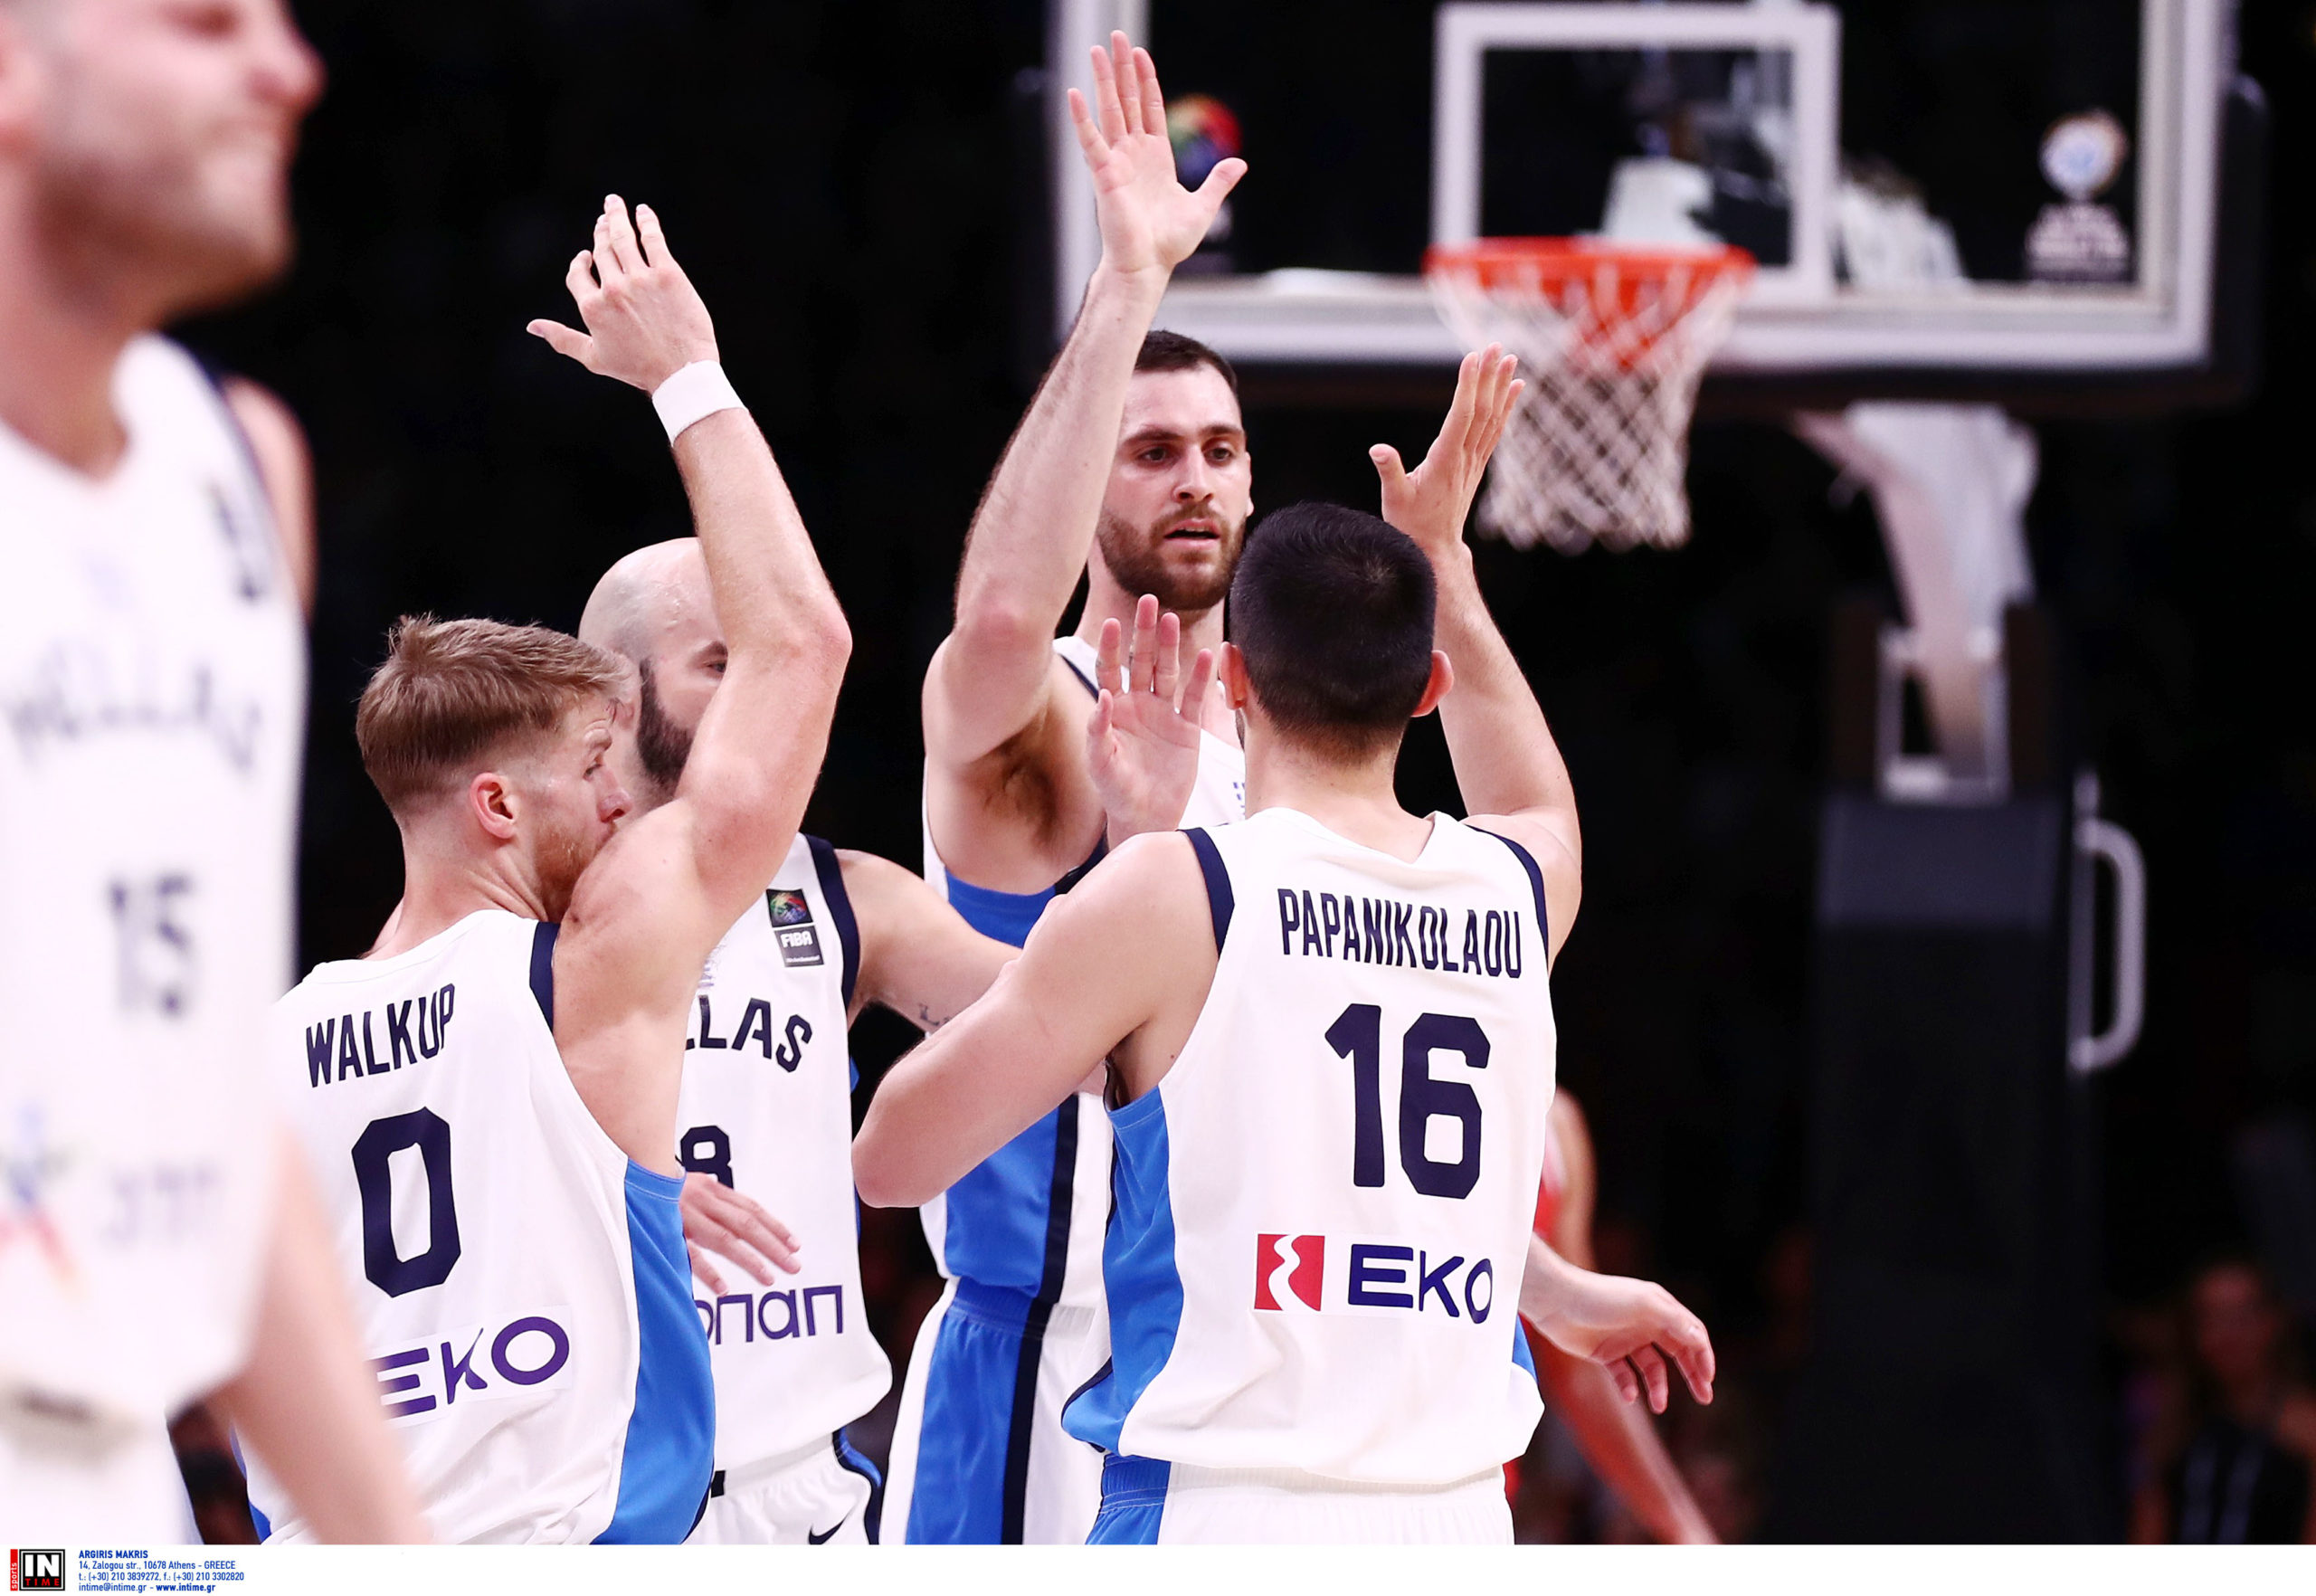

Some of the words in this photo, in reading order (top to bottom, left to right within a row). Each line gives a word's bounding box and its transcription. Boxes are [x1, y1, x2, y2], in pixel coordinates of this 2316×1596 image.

[105, 870, 194, 1015] 15
[781, 931, 813, 947] FIBA
[1277, 888, 1522, 979] PAPANIKOLAOU
[306, 983, 455, 1088] WALKUP
[685, 994, 813, 1073] LAS
[1324, 1003, 1490, 1200] 16
[351, 1107, 461, 1297] 0
[1348, 1244, 1492, 1324] EKO
[365, 1316, 570, 1417] EKO
